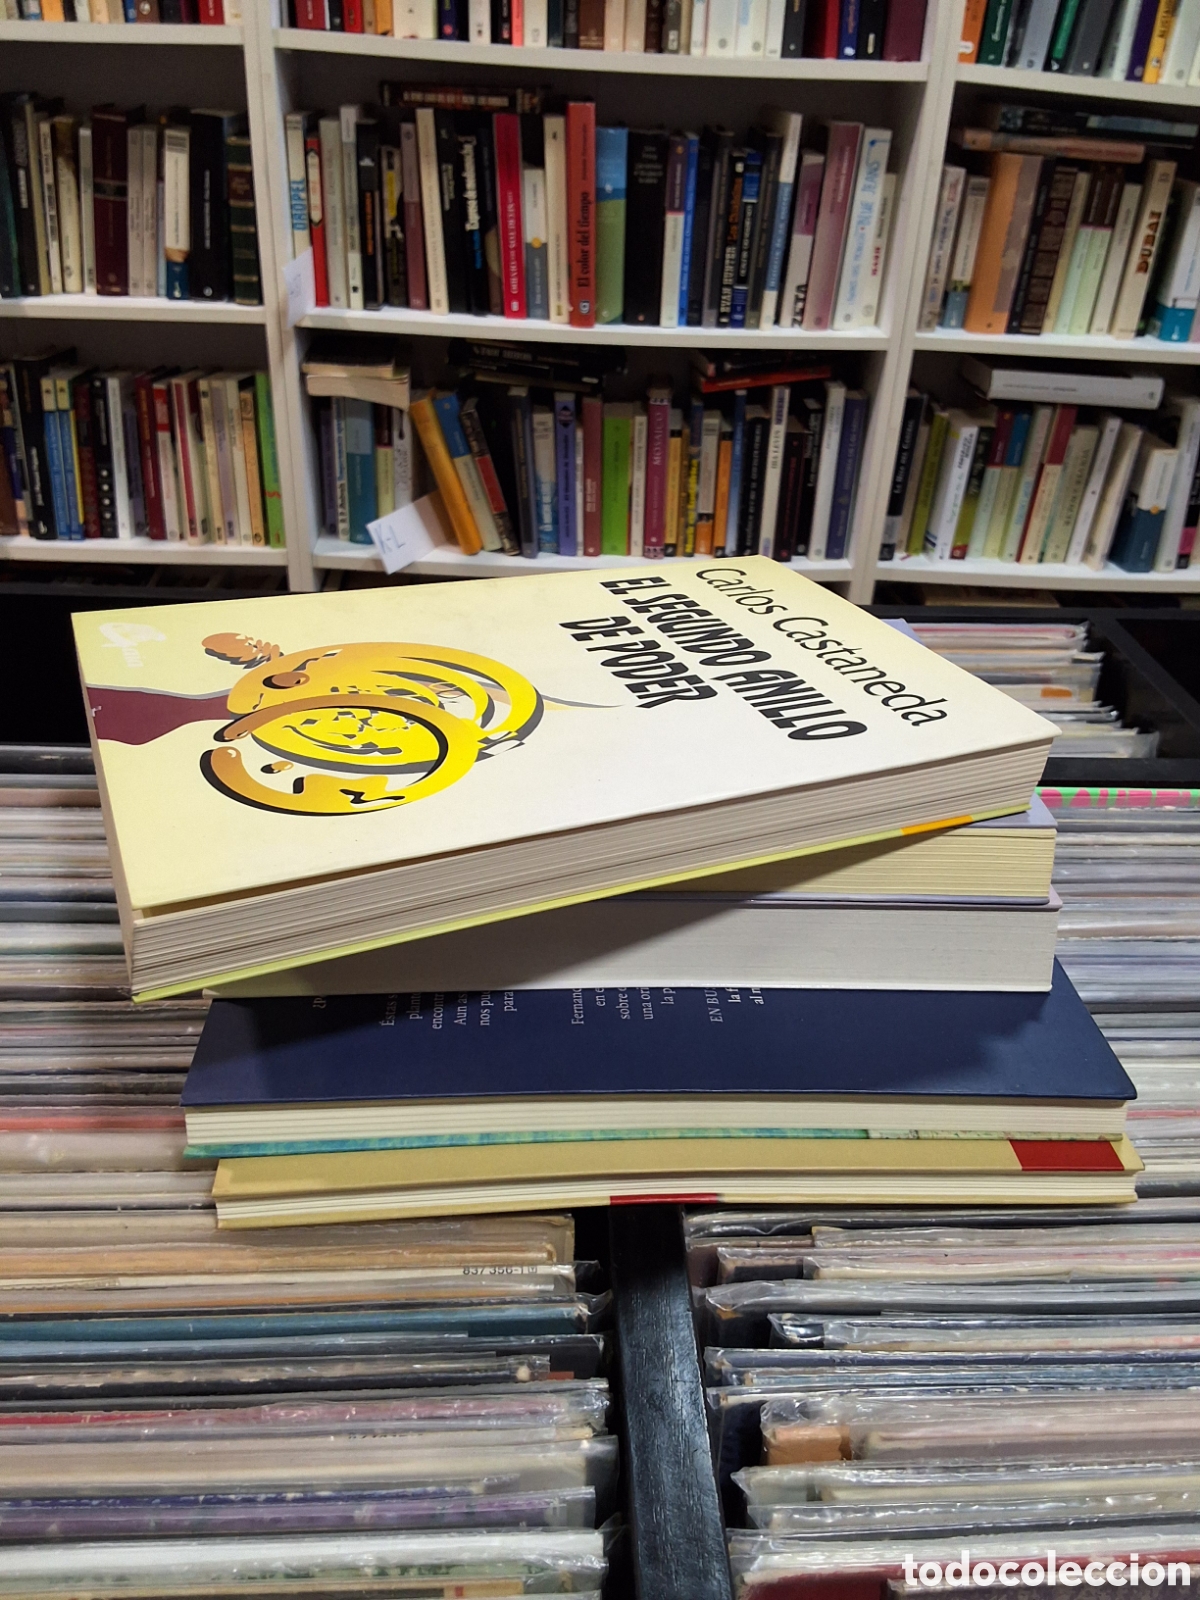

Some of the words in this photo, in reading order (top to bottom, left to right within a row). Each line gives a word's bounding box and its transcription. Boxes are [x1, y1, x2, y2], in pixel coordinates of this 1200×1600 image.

[575, 191, 592, 228] tiempo
[576, 230, 590, 246] del
[1135, 209, 1163, 275] DUBAI
[576, 249, 590, 275] color
[723, 245, 737, 285] HUNTER
[576, 277, 590, 287] El
[719, 286, 733, 313] EVAN
[792, 284, 808, 327] ZETA
[598, 575, 674, 596] EL
[558, 615, 644, 642] DE
[622, 593, 772, 667] SEGUNDO
[695, 567, 789, 616] Carlos
[772, 615, 949, 727] Castaneda
[586, 638, 719, 709] PODER
[709, 668, 868, 741] ANILLO
[312, 995, 327, 1009] ¿P
[457, 991, 468, 1004] as
[503, 991, 518, 1012] para
[594, 995, 606, 1006] en
[615, 993, 631, 1020] sobre
[660, 996, 675, 1005] la
[704, 987, 720, 1005] BU
[727, 994, 741, 1003] la
[748, 995, 764, 1005] al
[378, 1001, 397, 1026] Éstas
[431, 991, 444, 1030] encontr
[453, 1005, 468, 1025] Aun
[479, 1008, 490, 1026] nos
[641, 1001, 654, 1020] una
[707, 1007, 724, 1023] EN
